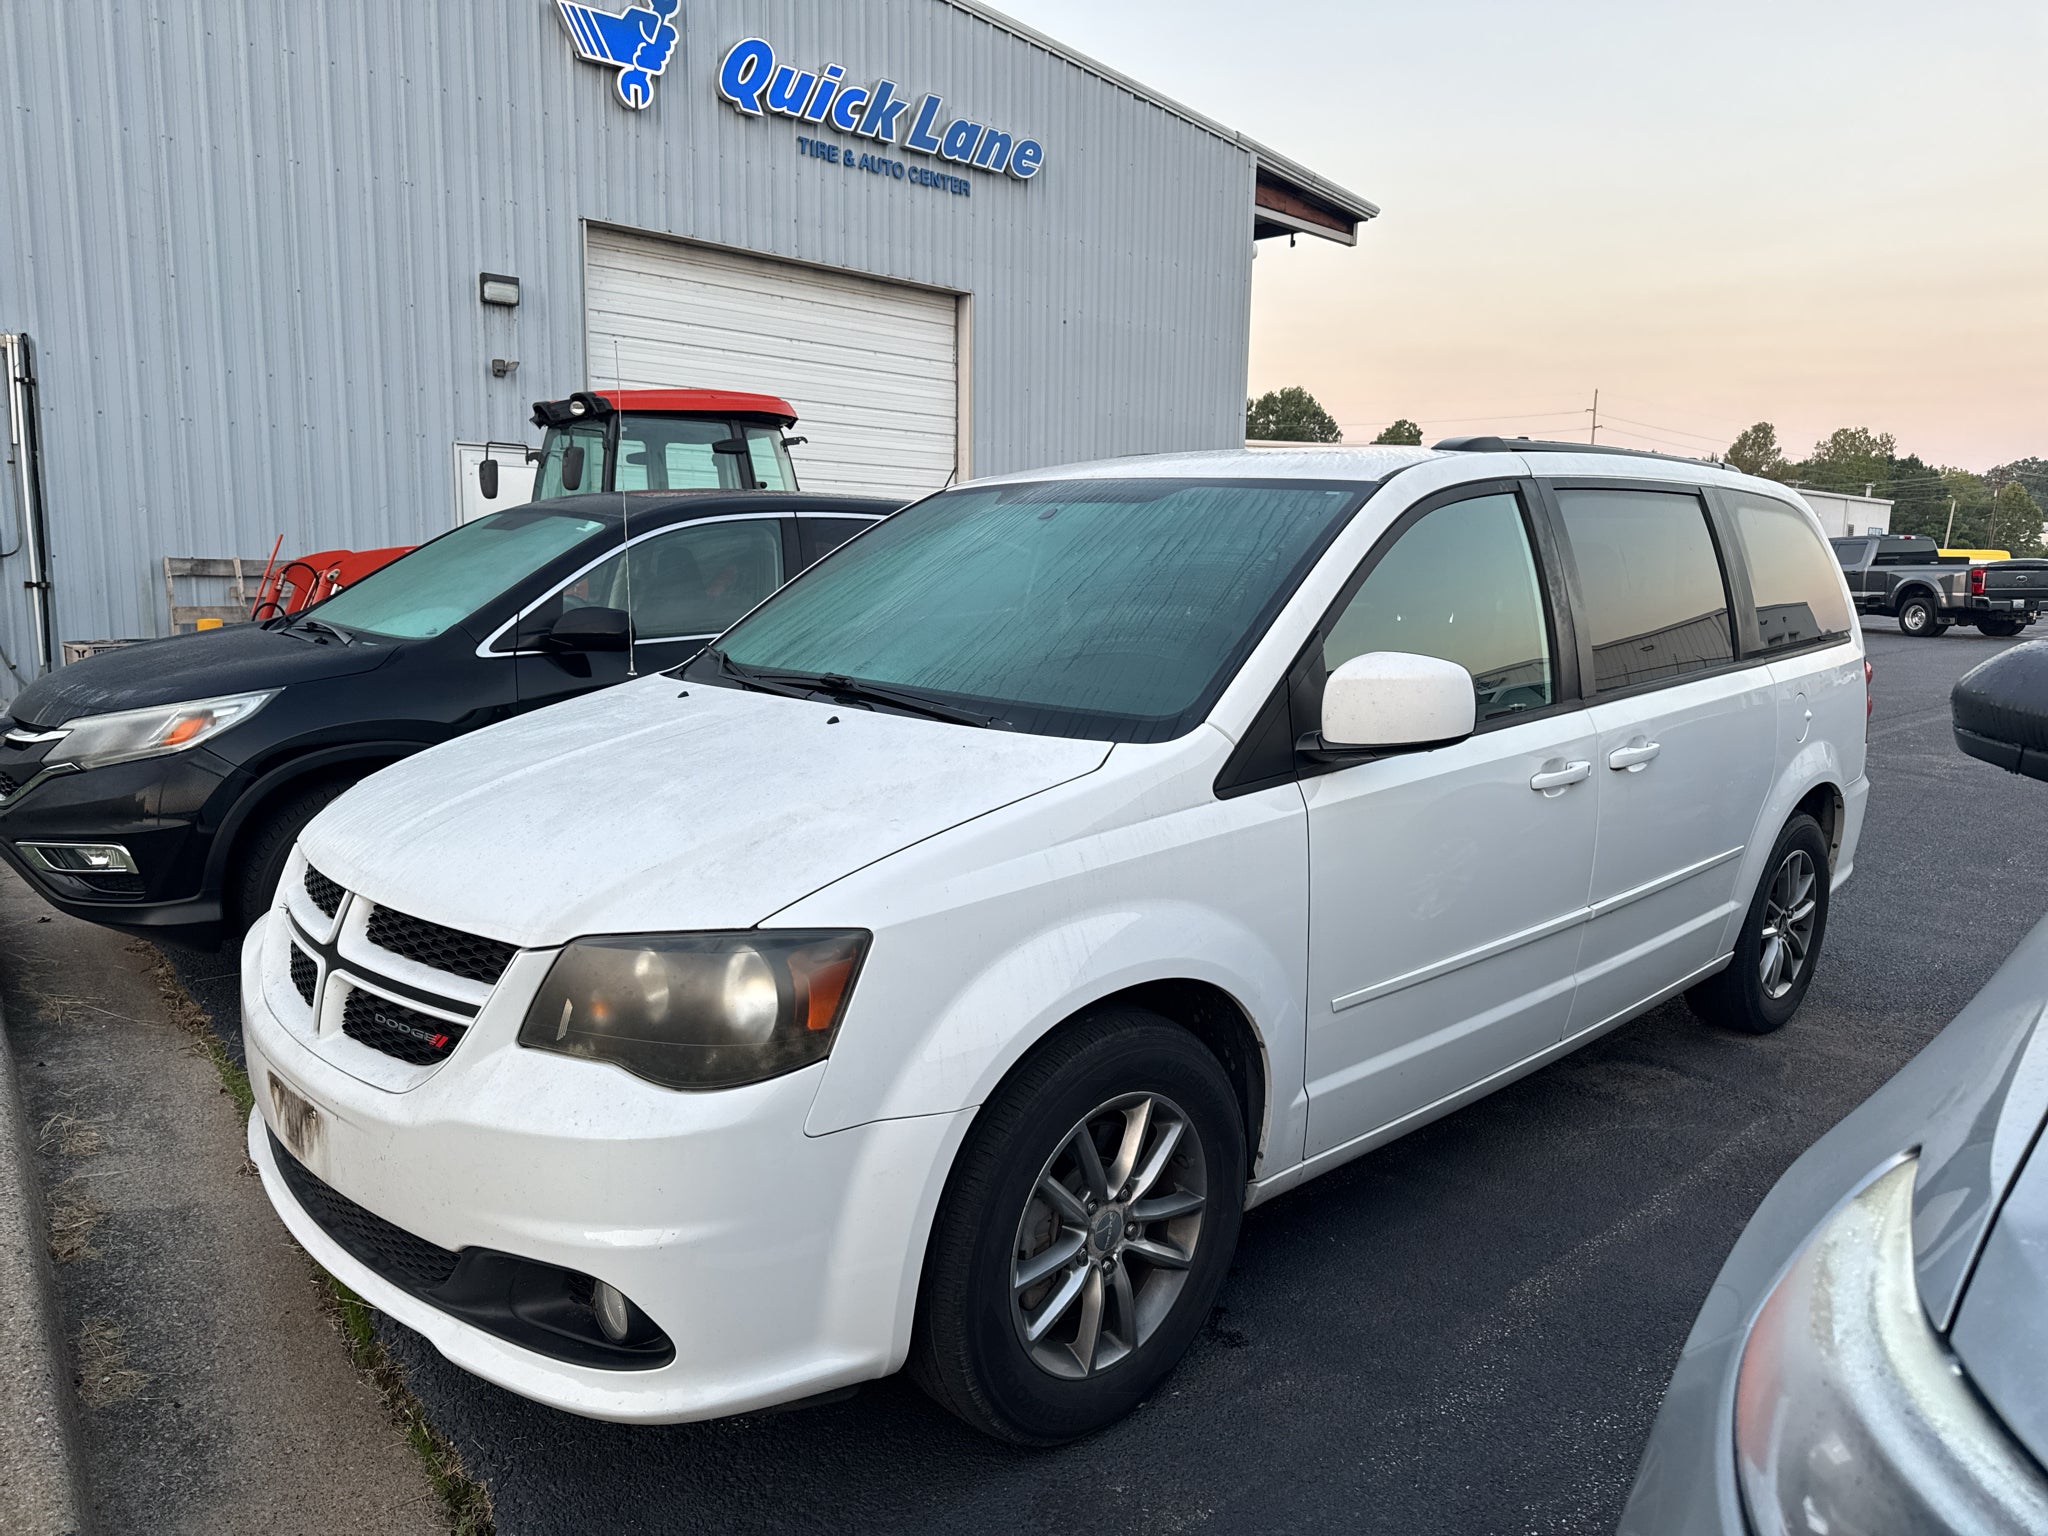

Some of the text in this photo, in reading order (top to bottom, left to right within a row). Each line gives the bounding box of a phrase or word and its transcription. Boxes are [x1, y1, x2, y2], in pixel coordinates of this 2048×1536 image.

[718, 37, 1044, 179] Quick Lane
[798, 136, 971, 197] TIRE & AUTO CENTER
[374, 1013, 436, 1042] DODGE
